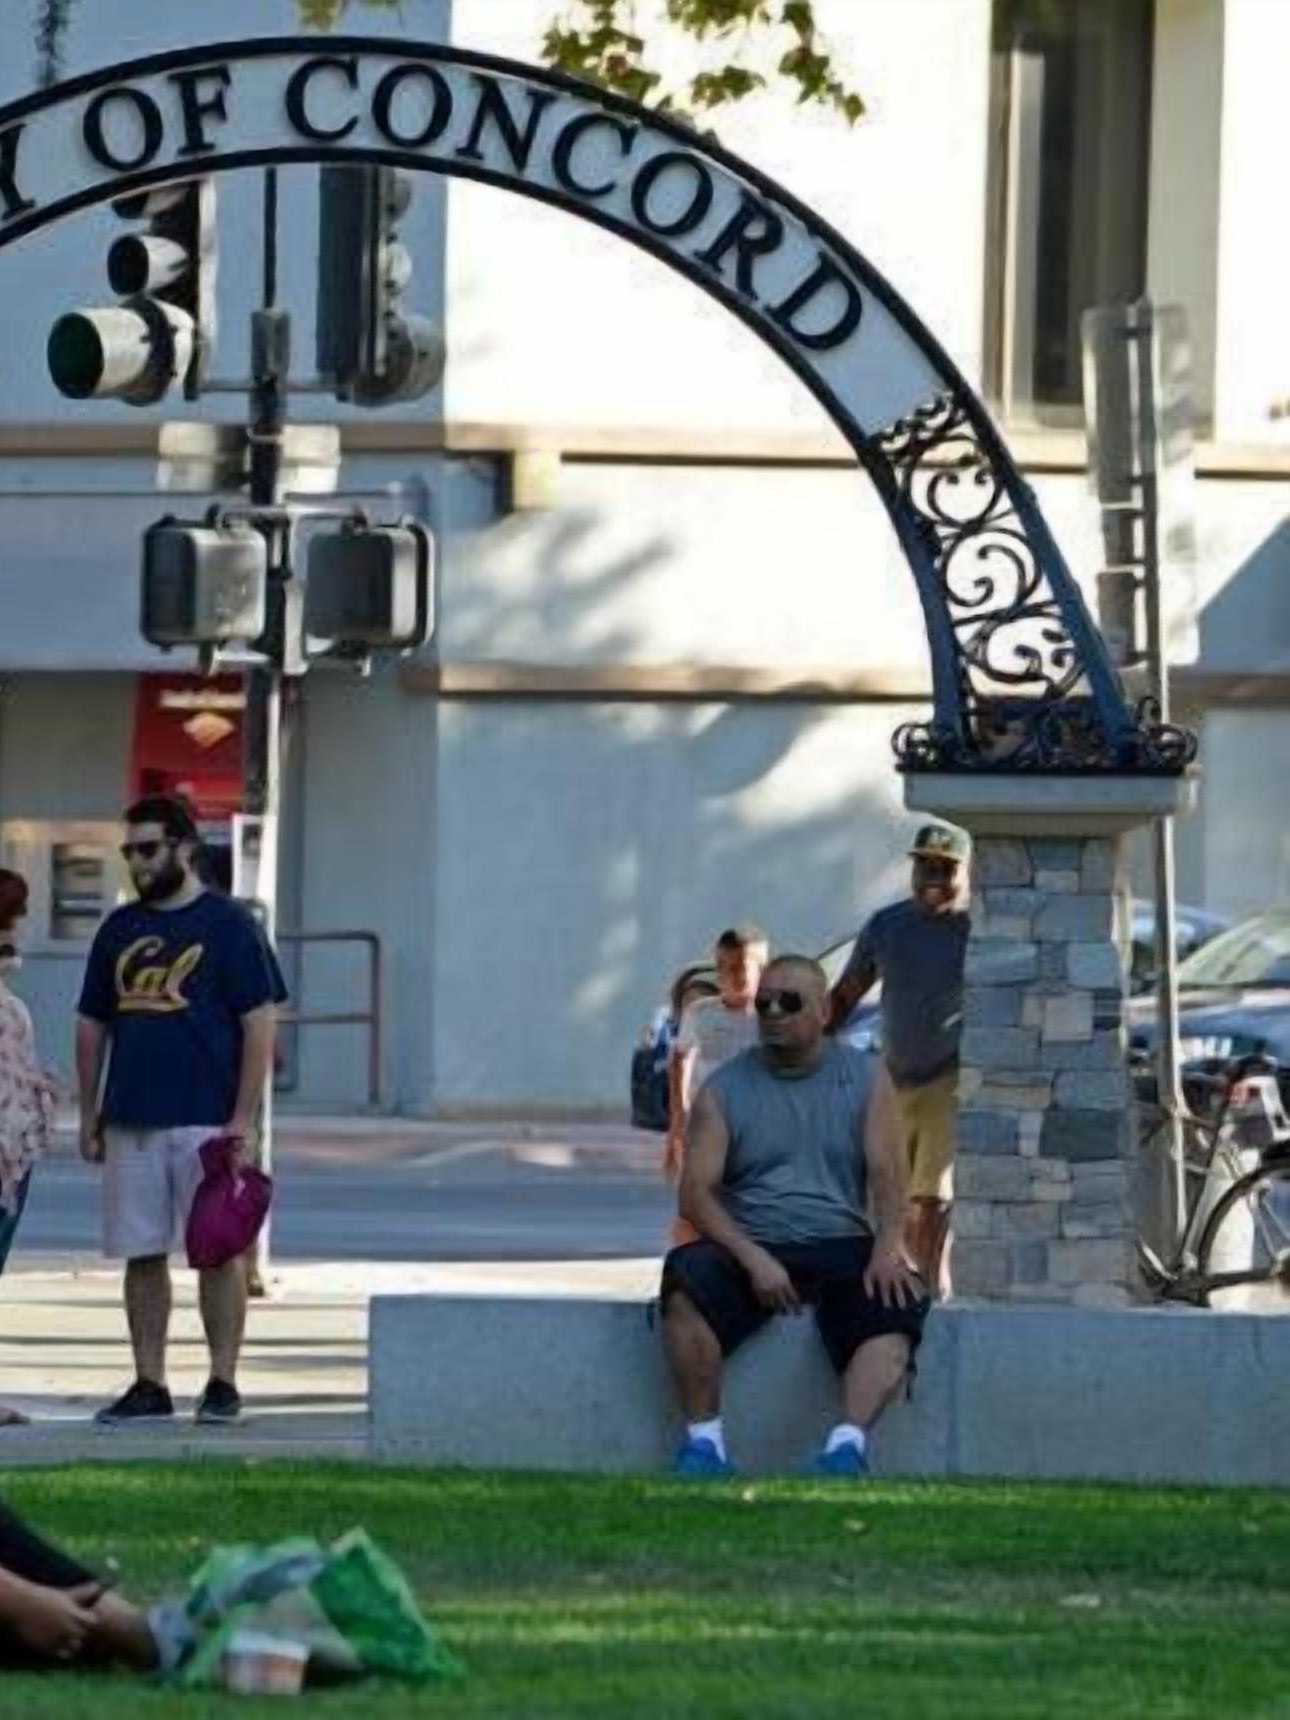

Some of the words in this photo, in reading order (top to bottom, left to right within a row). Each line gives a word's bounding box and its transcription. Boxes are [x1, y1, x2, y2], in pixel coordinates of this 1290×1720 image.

[83, 66, 232, 172] OF
[285, 56, 864, 351] CONCORD
[115, 936, 204, 1011] Cal
